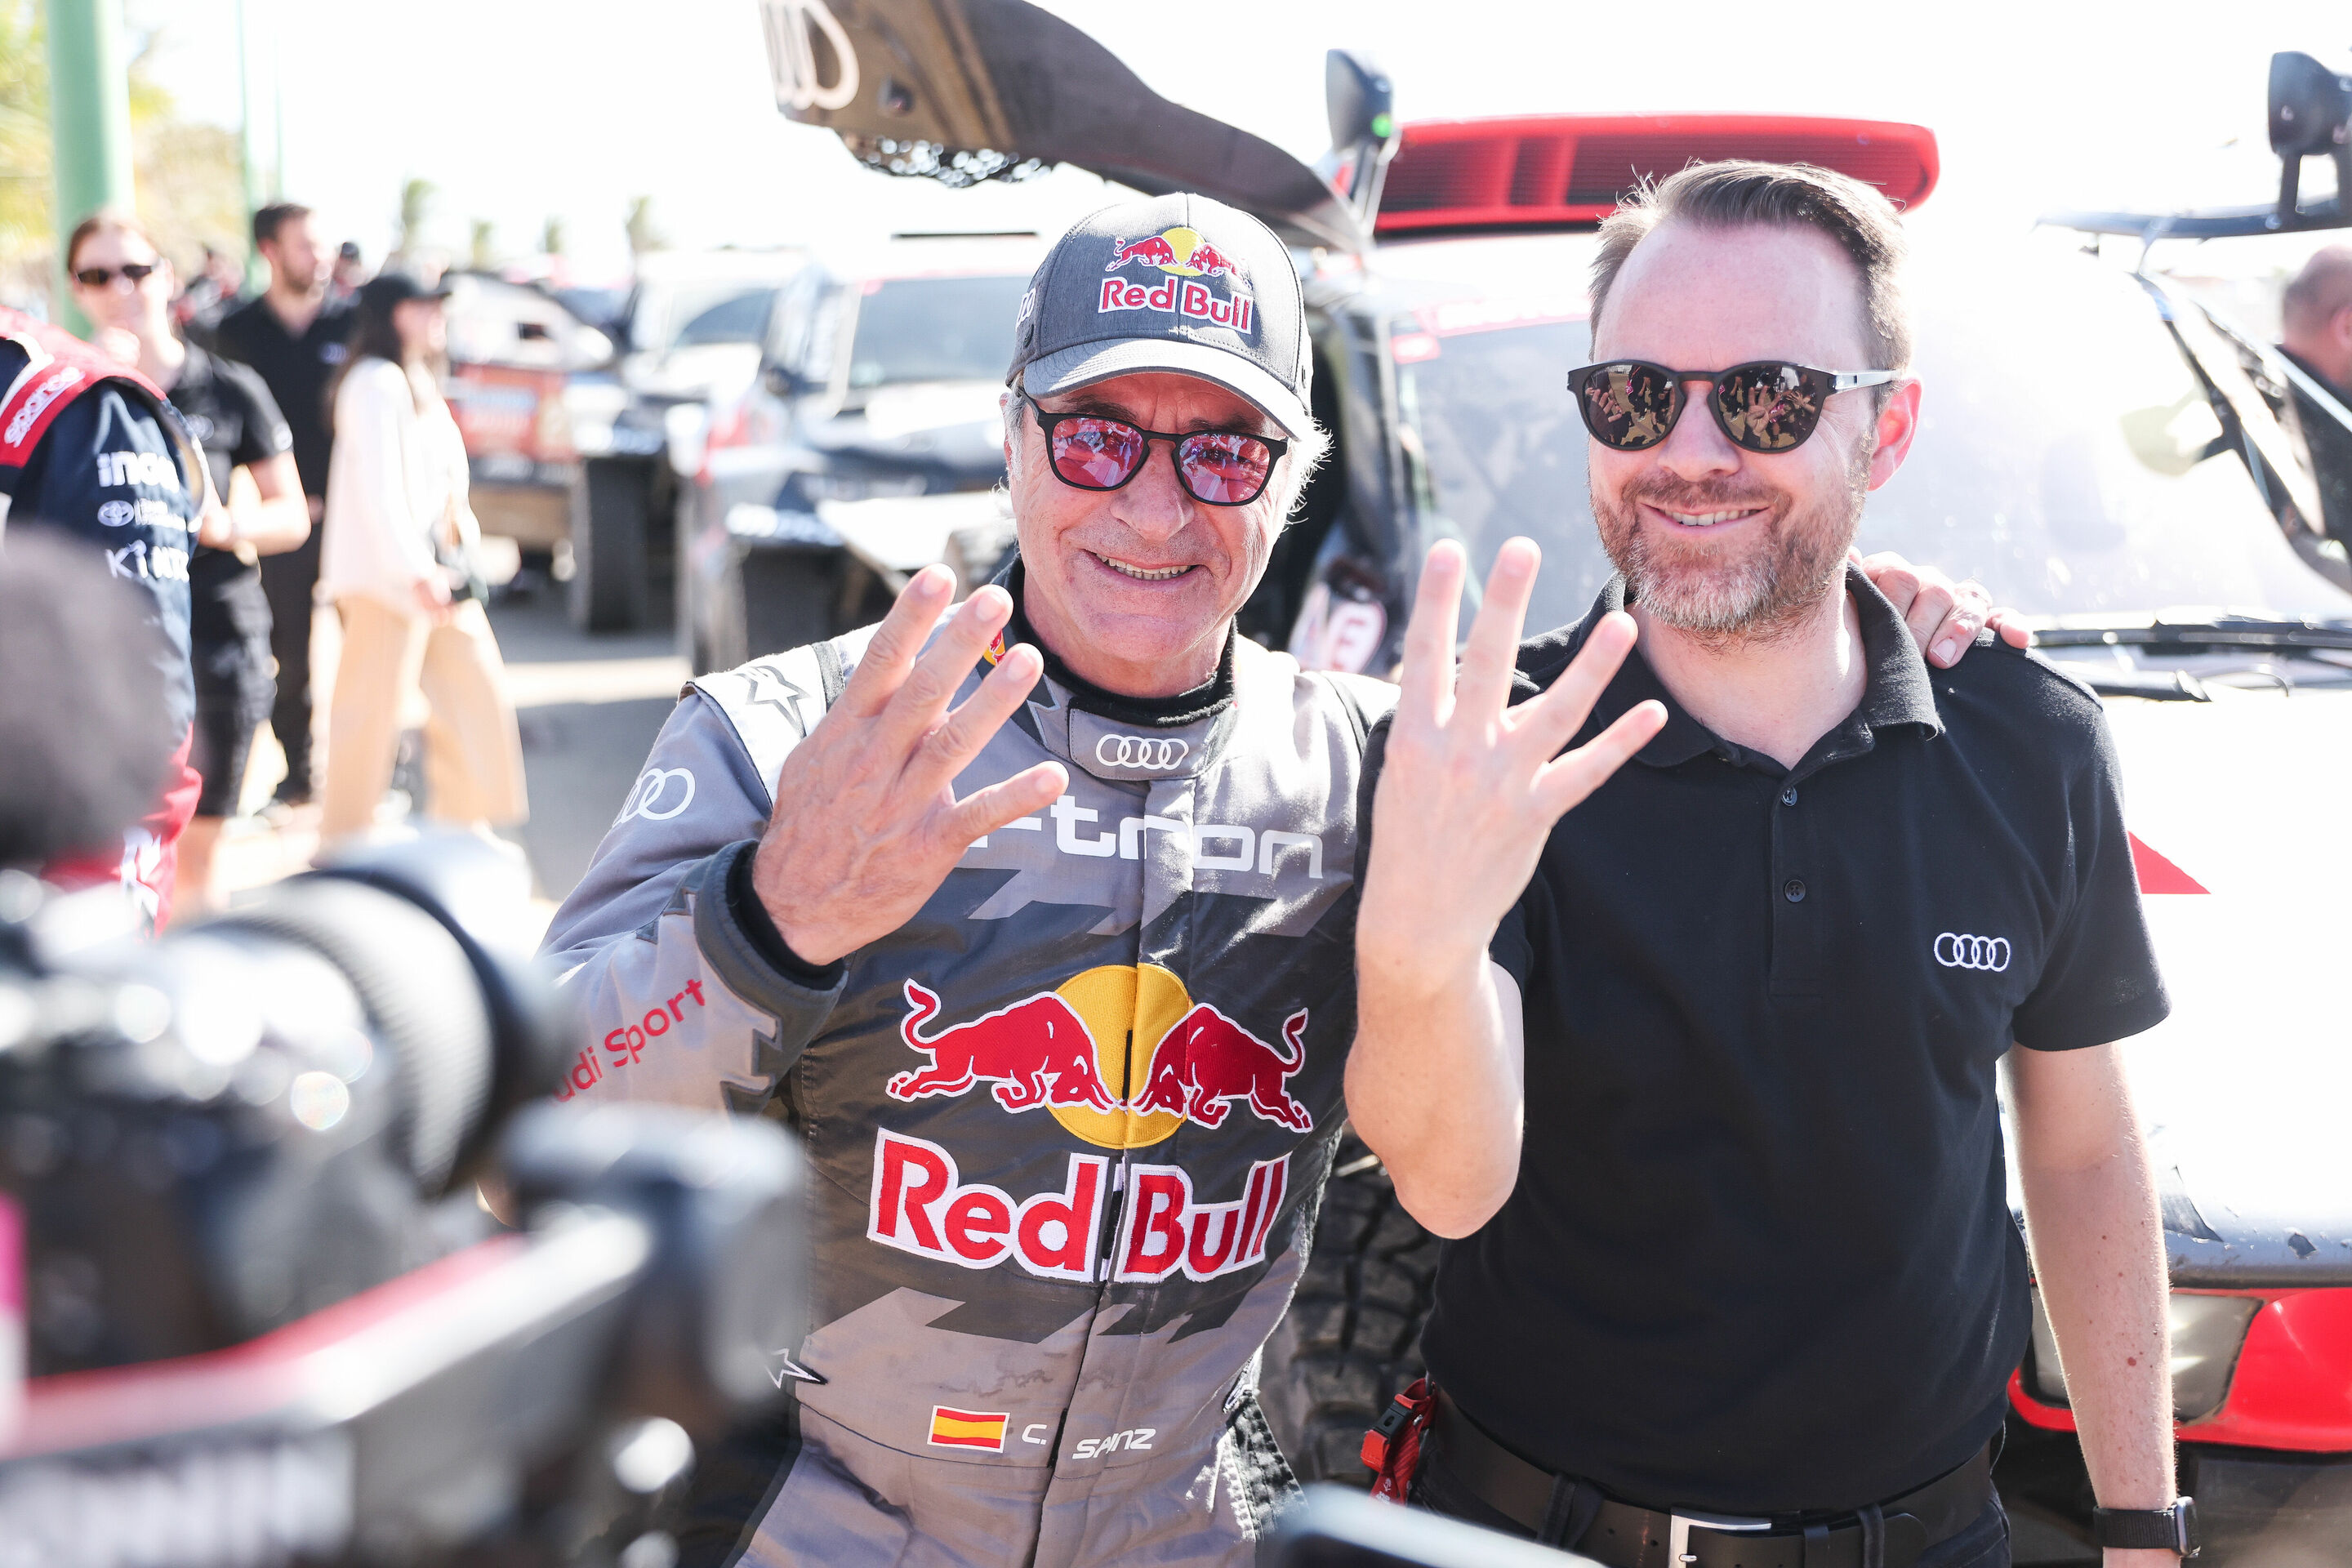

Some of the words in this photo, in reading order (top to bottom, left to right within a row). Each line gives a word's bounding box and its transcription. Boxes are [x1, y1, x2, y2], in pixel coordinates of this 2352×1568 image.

[1101, 277, 1175, 311] Red
[1183, 283, 1253, 332] Bull
[968, 795, 1323, 879] -tron
[552, 1046, 604, 1103] udi
[604, 978, 706, 1068] Sport
[874, 1137, 1101, 1276] Red
[1120, 1157, 1289, 1277] Bull
